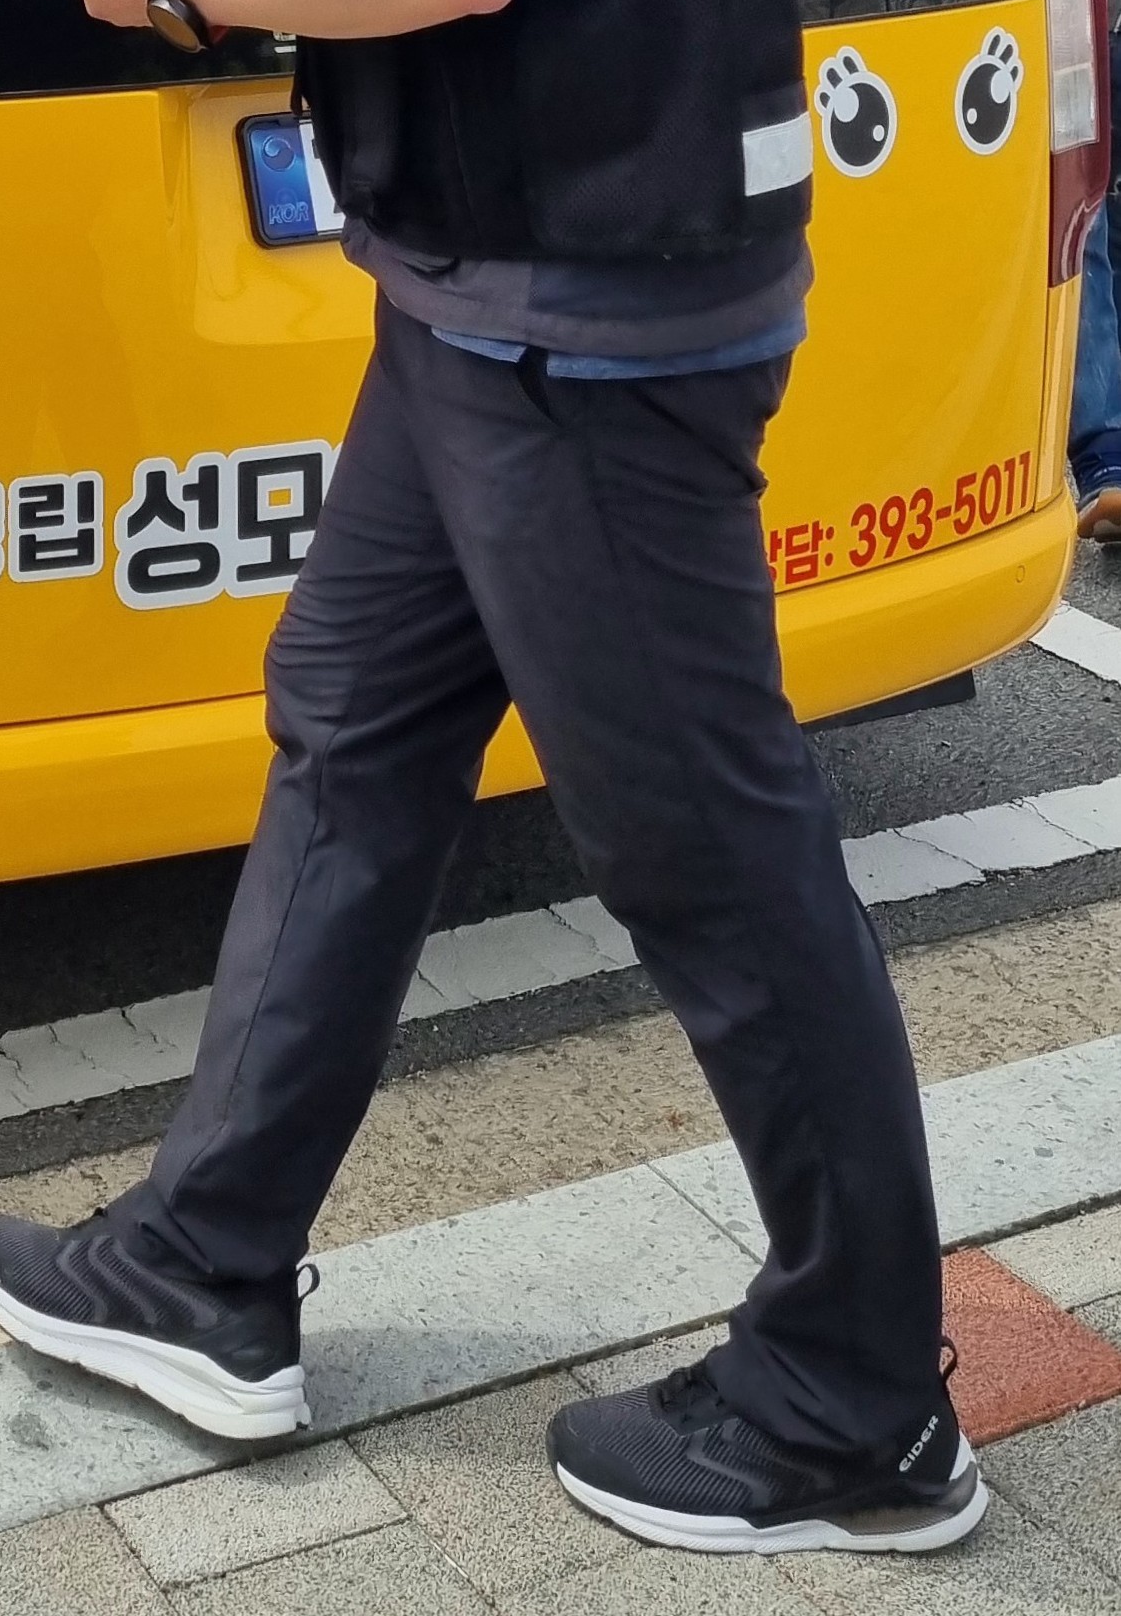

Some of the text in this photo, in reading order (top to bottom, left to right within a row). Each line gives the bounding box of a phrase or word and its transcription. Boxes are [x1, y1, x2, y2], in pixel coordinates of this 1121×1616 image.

[268, 201, 310, 225] KOR
[848, 451, 1031, 568] 393-5011
[898, 1415, 939, 1472] EIDER
